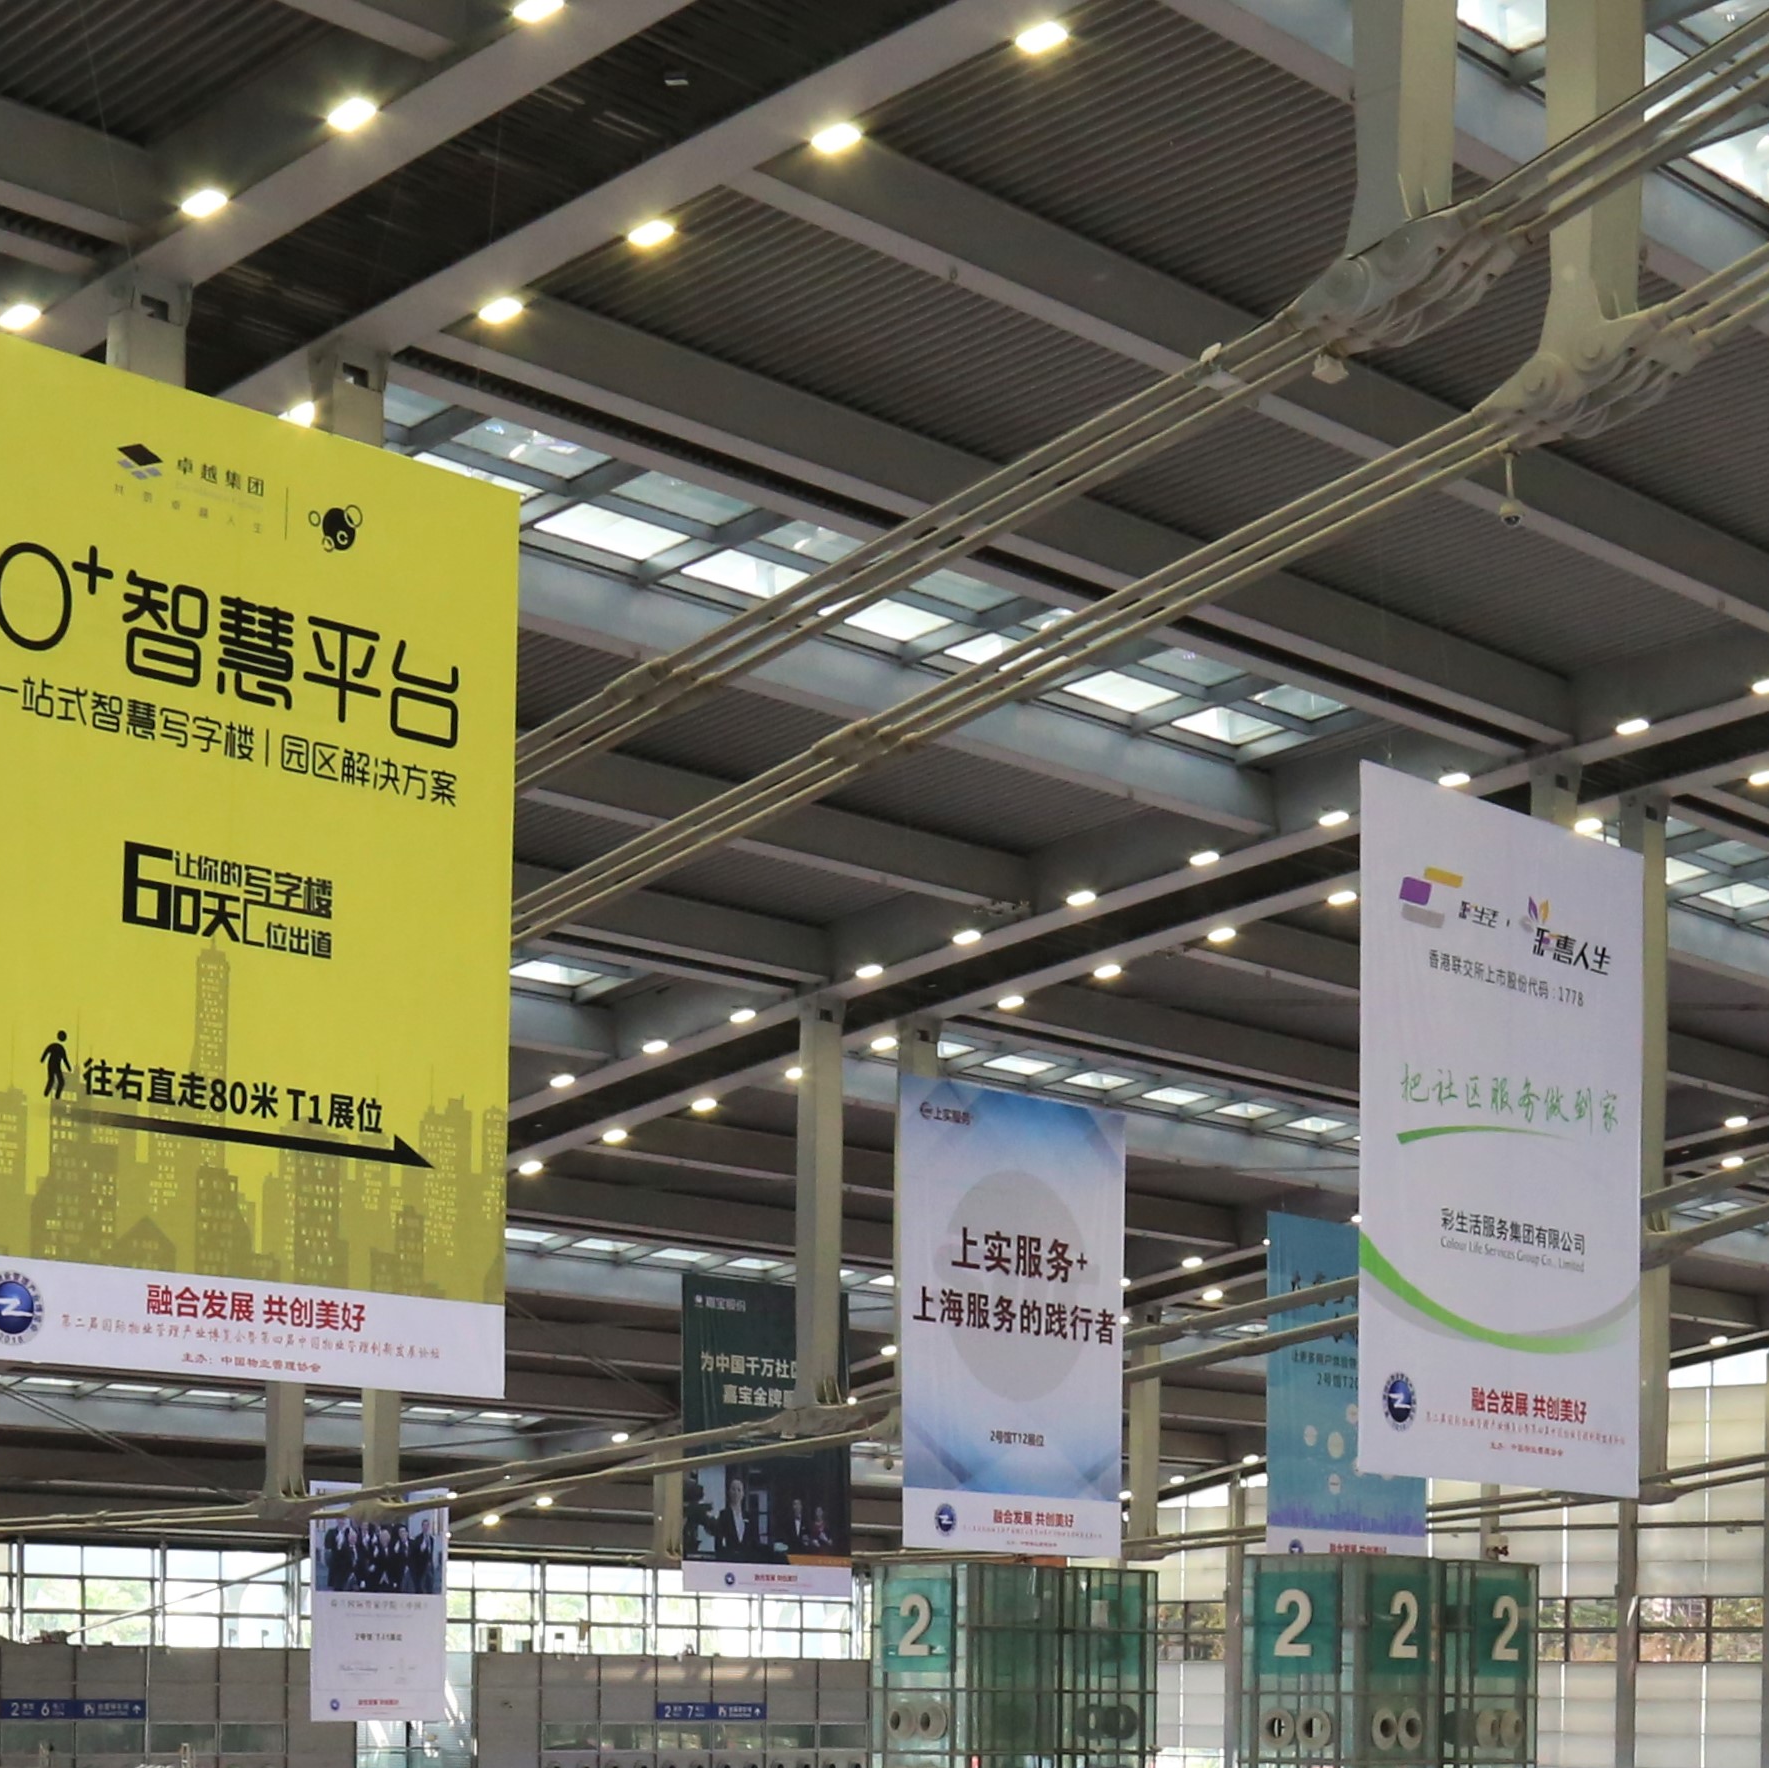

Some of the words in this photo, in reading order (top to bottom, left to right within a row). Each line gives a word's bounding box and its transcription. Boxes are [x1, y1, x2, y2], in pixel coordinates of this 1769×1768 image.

[1441, 1207, 1585, 1255] 彩生活服务集团有限公司
[146, 1284, 255, 1324] 融合发展
[263, 1294, 367, 1332] 共创美好
[912, 1286, 1117, 1345] 上海服务的践行者
[1471, 1387, 1528, 1417] 融合发展
[1533, 1394, 1587, 1424] 共创美好
[897, 1593, 933, 1657] 2
[1274, 1588, 1314, 1658] 2
[1388, 1590, 1420, 1660] 2
[1490, 1595, 1520, 1662] 2
[11, 1702, 19, 1716] 2
[41, 1703, 50, 1716] 6
